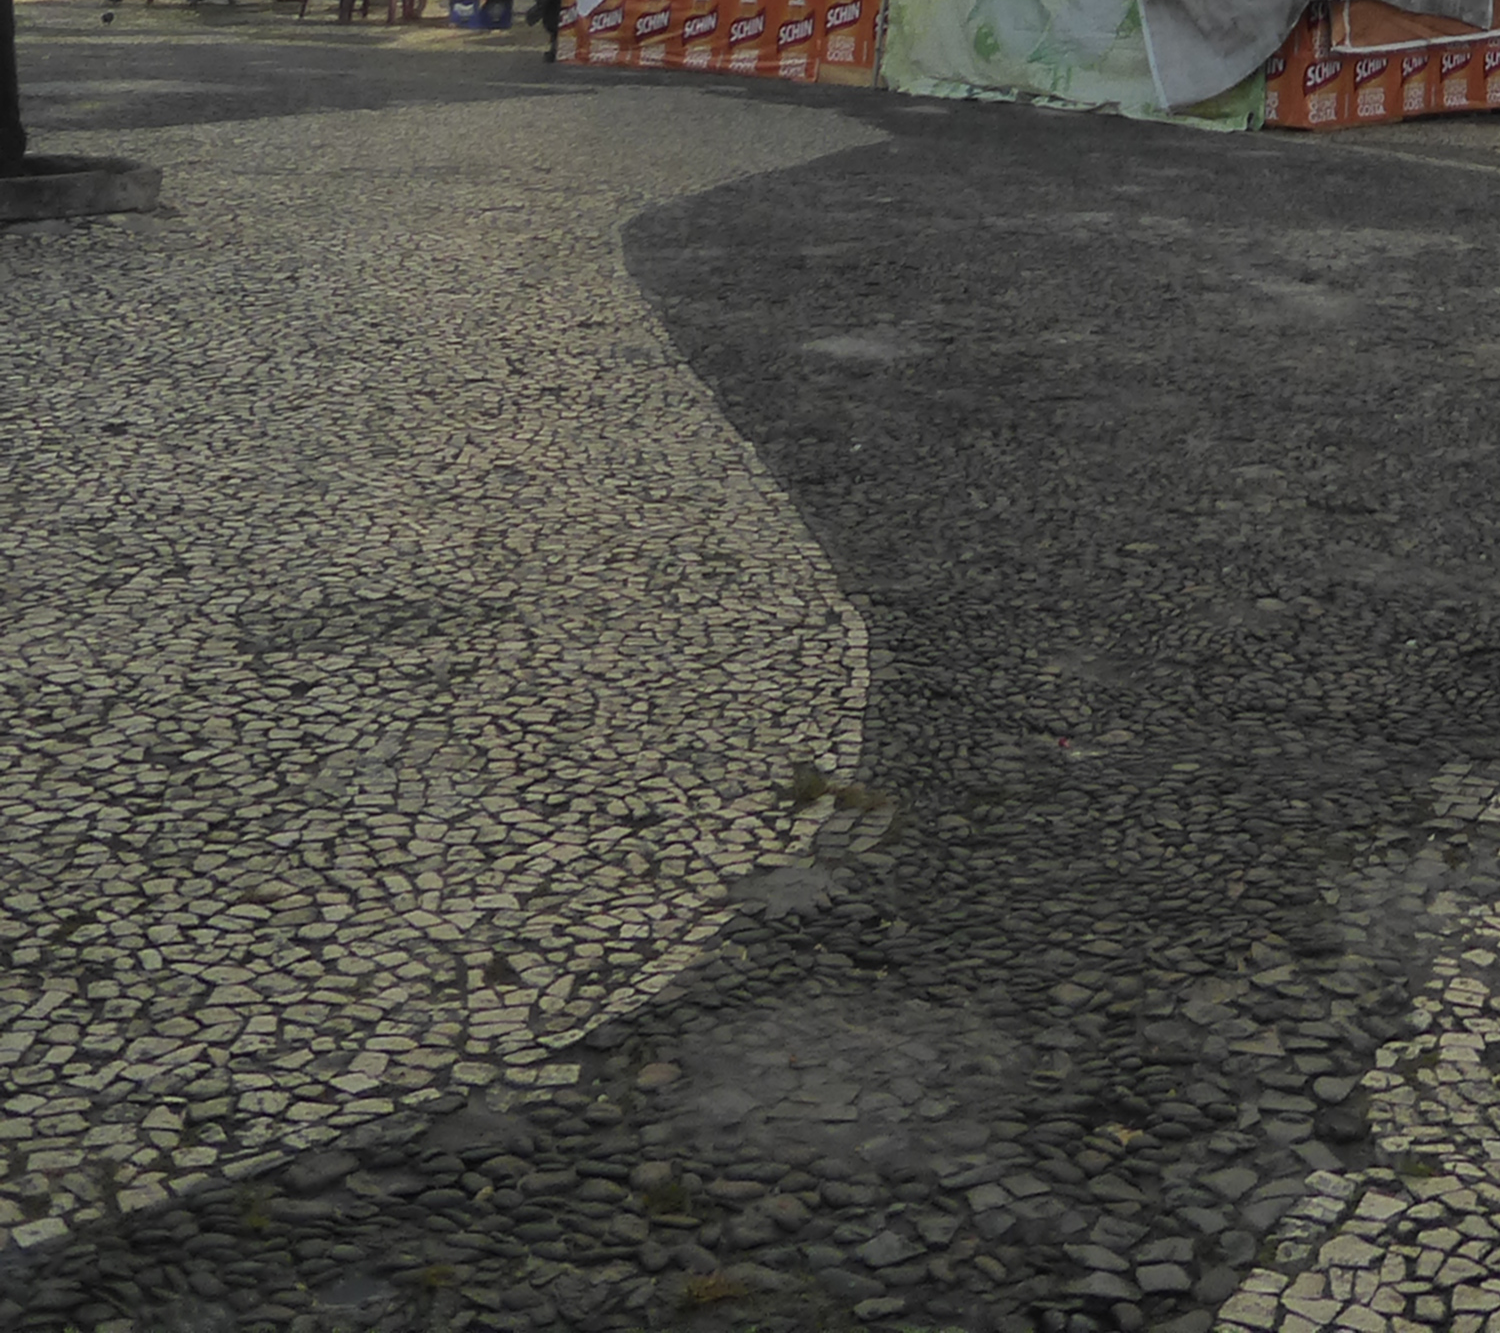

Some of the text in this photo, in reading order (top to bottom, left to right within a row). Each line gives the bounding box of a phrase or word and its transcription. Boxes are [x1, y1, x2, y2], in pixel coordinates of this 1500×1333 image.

[589, 8, 623, 33] SCHIN
[636, 11, 670, 36] SCHIN
[684, 13, 717, 38] SCHIN
[730, 15, 765, 42] SCHIN
[778, 19, 814, 45] SCHIN
[826, 1, 861, 28] SCHIN
